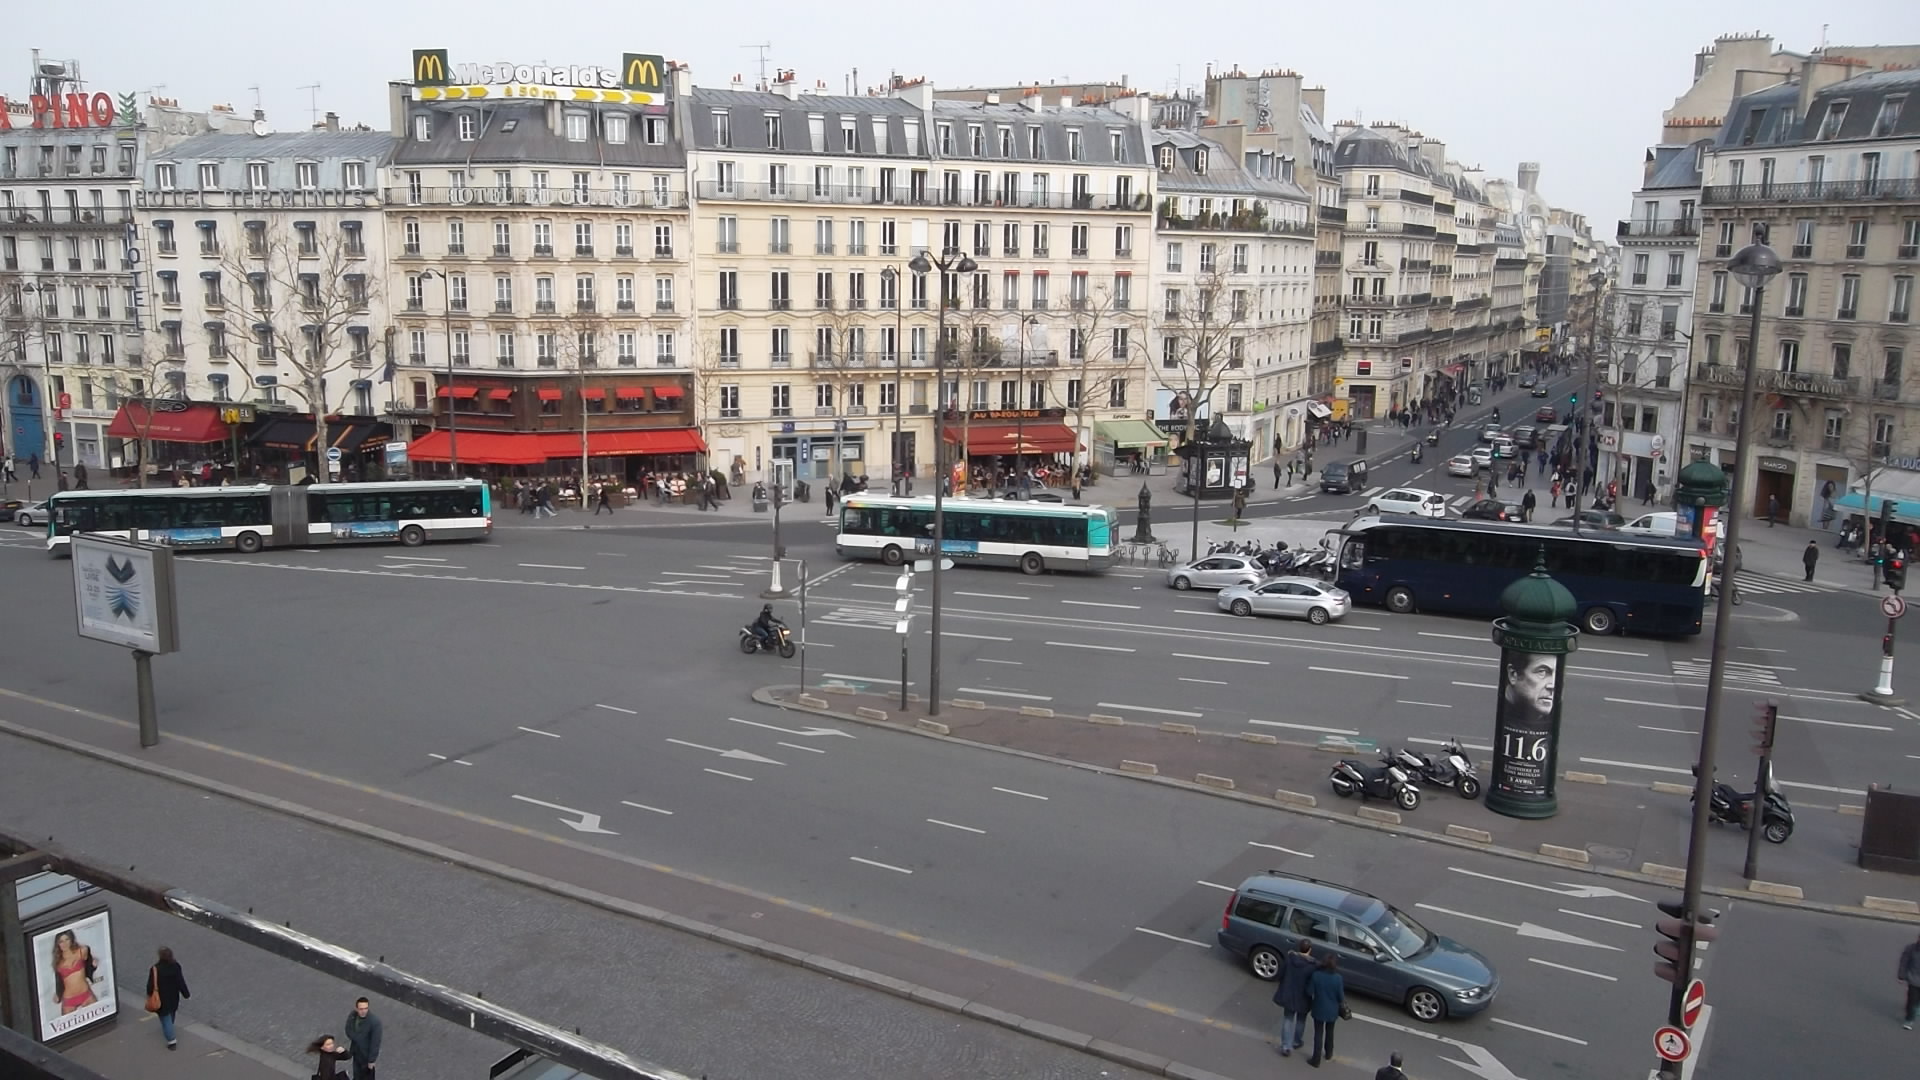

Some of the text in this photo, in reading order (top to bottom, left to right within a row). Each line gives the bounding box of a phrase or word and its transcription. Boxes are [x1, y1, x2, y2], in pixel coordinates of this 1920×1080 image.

[454, 61, 617, 88] McDonald's
[519, 86, 539, 98] 50
[542, 89, 557, 99] m
[29, 91, 116, 128] PINO
[135, 188, 366, 208] HOTEL TERMINUS
[126, 223, 146, 331] HOTEL
[220, 407, 249, 418] HEL
[1158, 424, 1170, 432] THE
[1763, 460, 1788, 471] MANGO
[1503, 734, 1547, 762] 11.6
[50, 1004, 110, 1034] Variance
